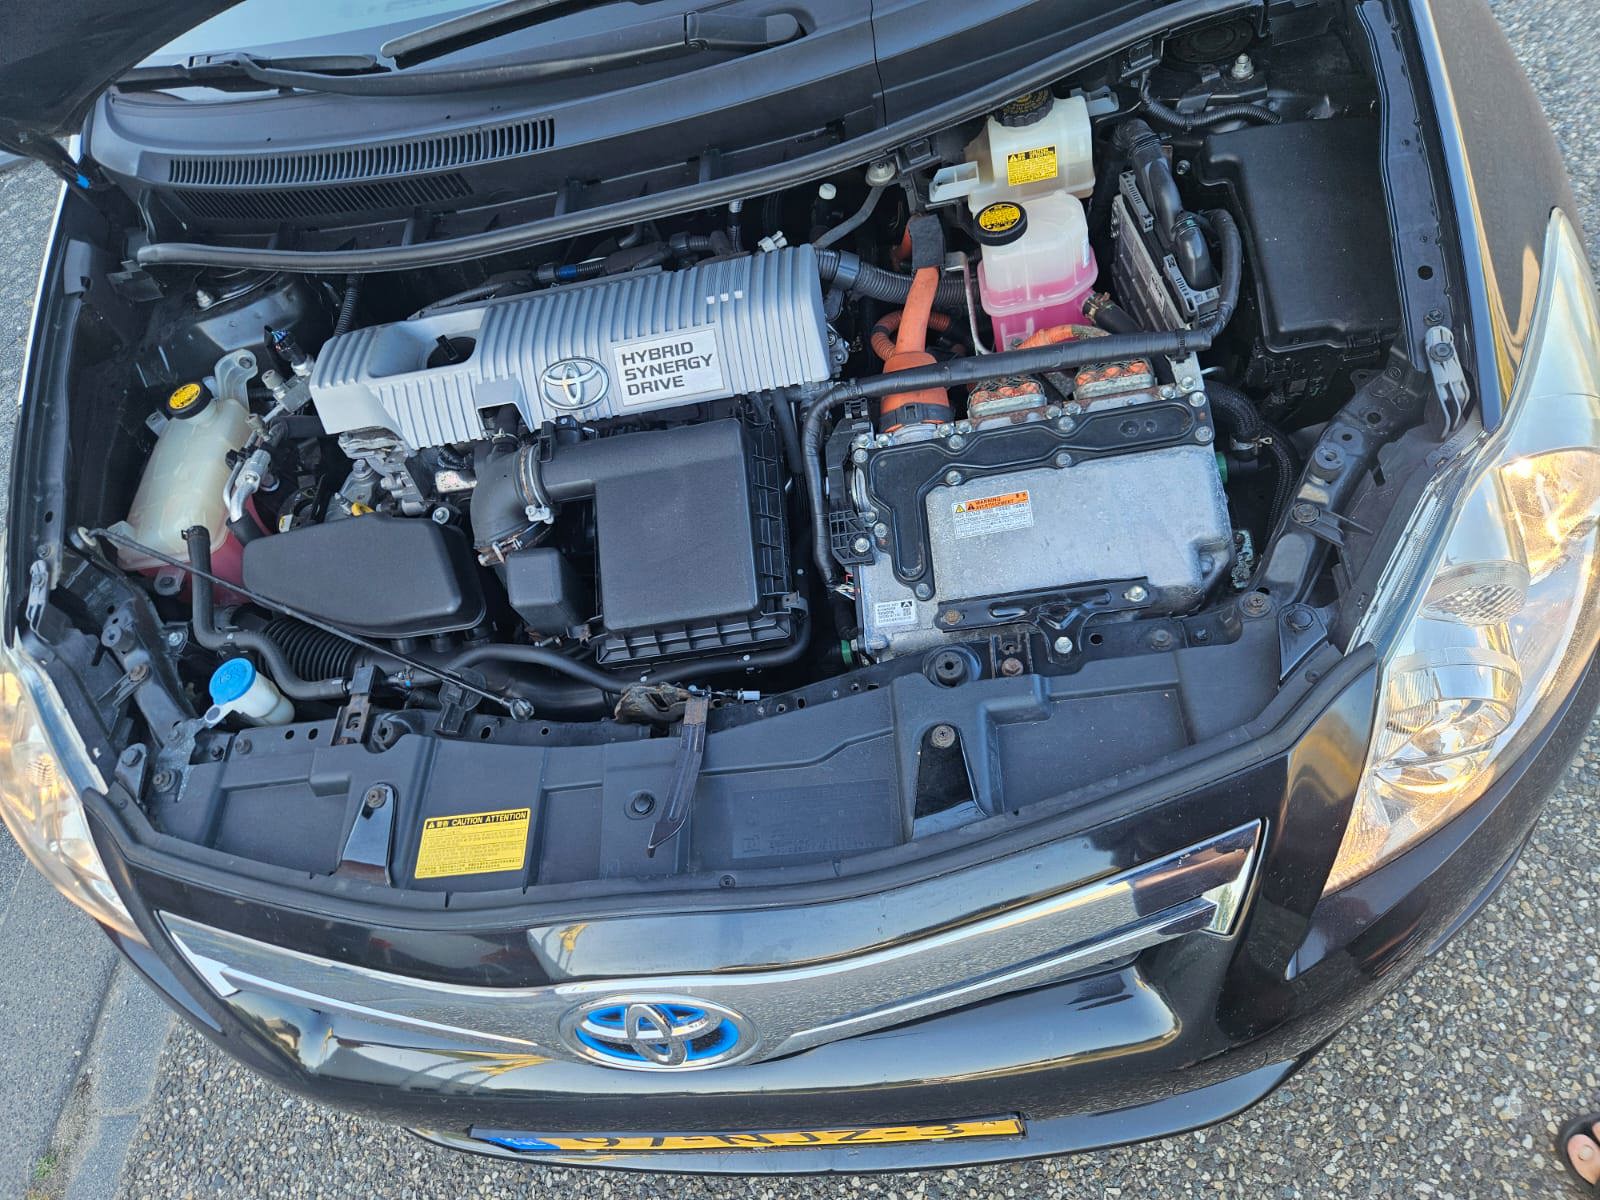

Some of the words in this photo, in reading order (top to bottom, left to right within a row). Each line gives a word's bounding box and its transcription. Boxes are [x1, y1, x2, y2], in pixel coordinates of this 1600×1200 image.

[621, 342, 693, 366] HYBRID
[624, 353, 713, 381] SYNERGY
[627, 376, 685, 395] DRIVE
[452, 817, 482, 826] CAUTION
[486, 812, 526, 823] ATTENTION
